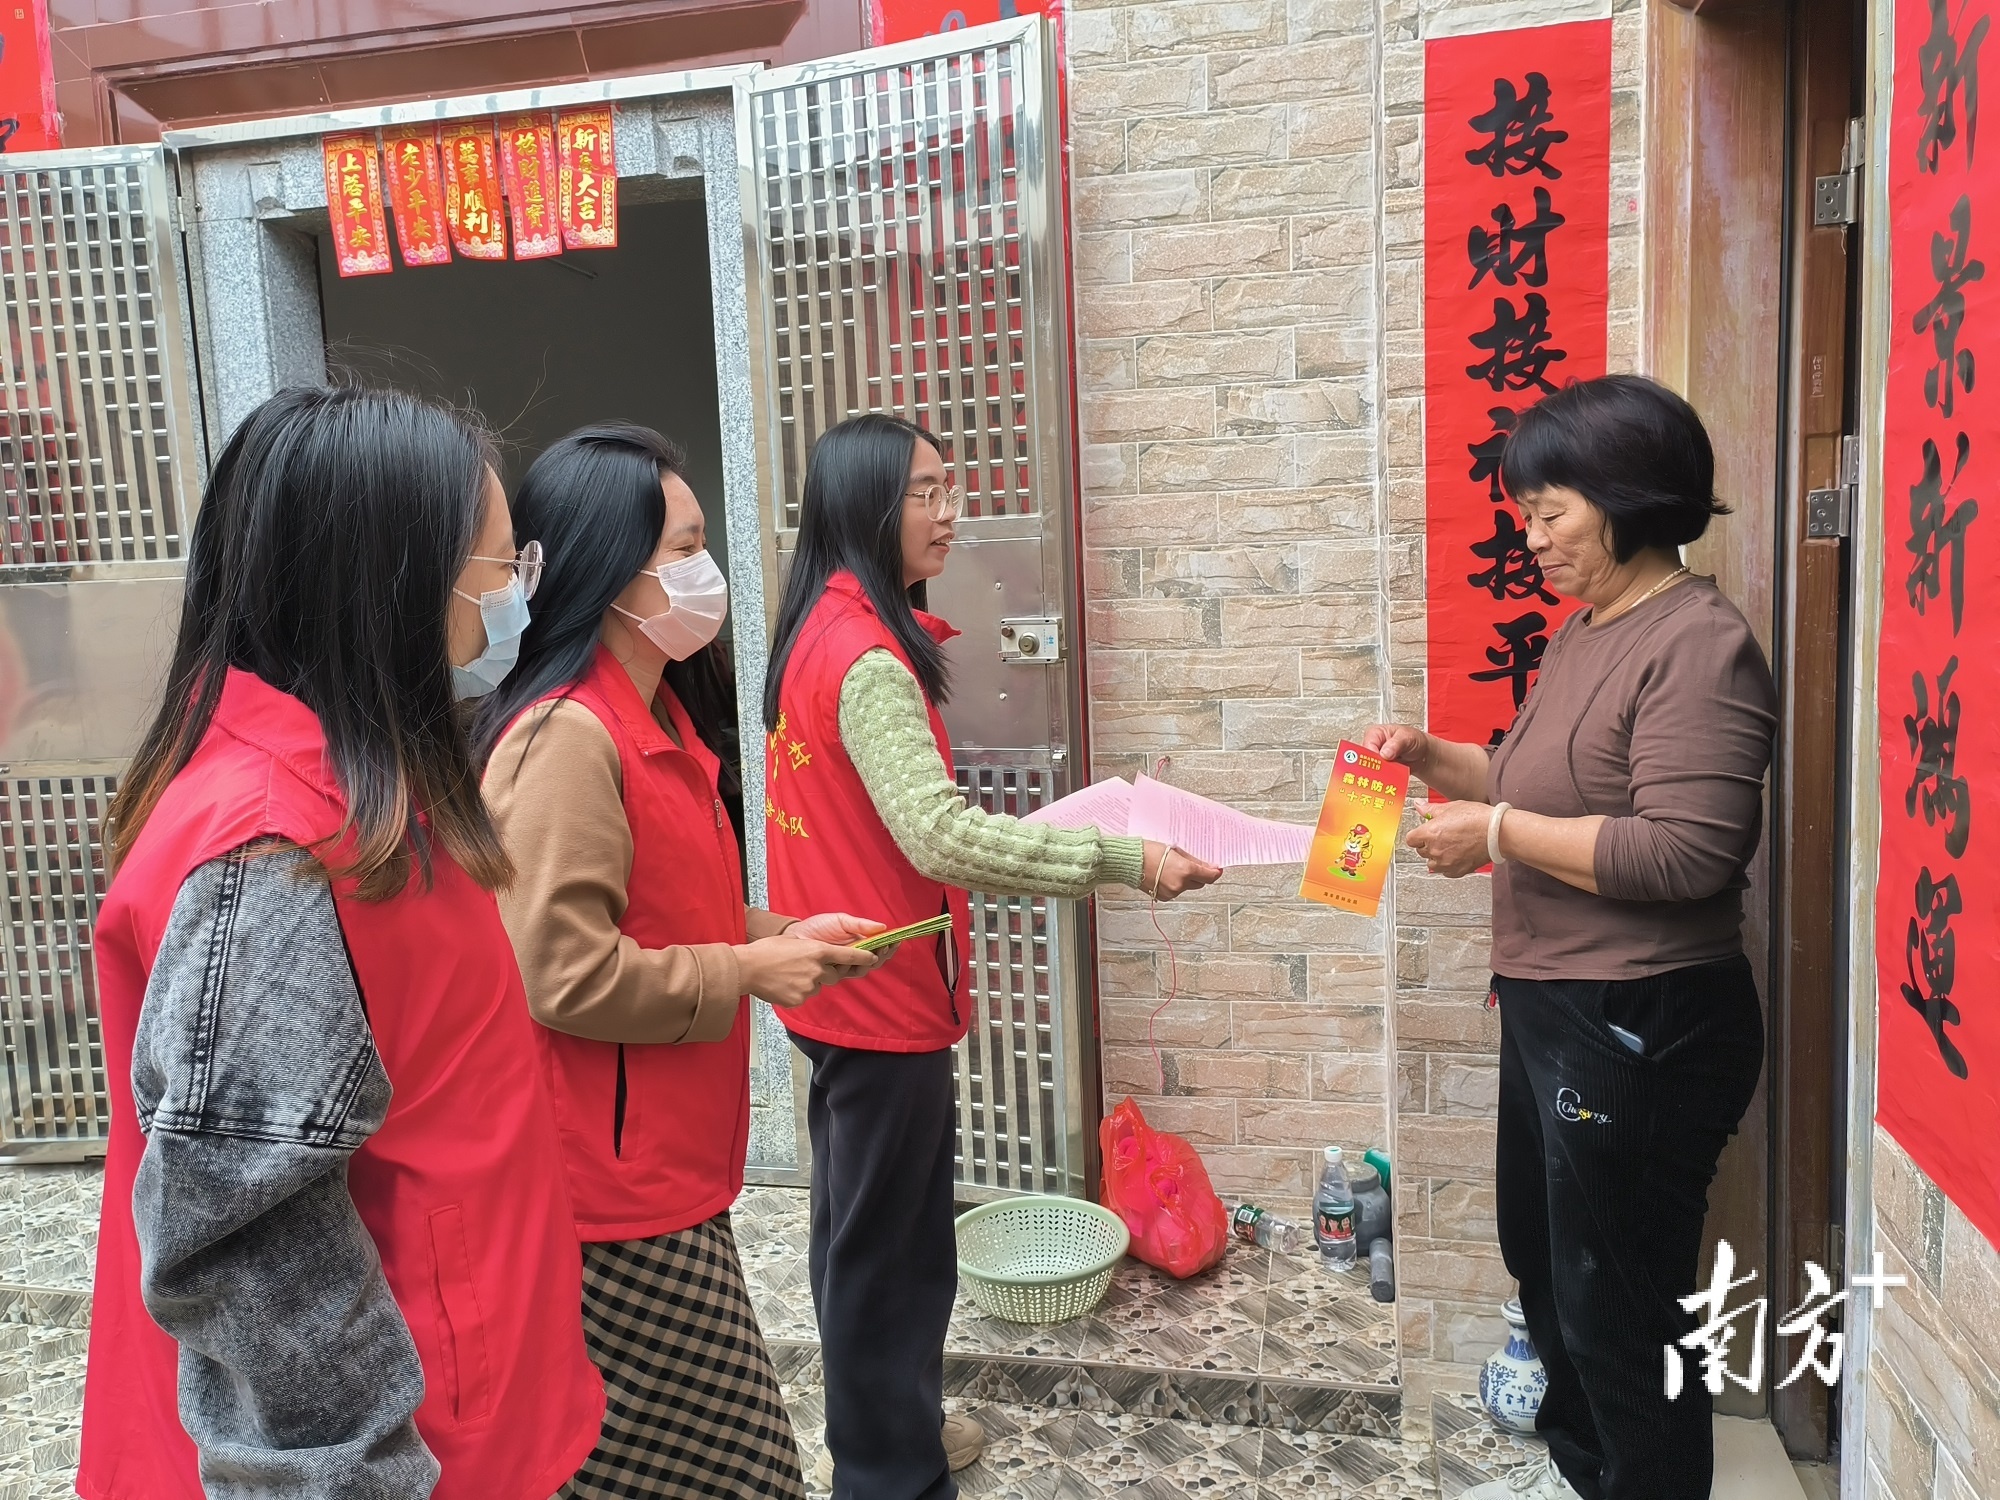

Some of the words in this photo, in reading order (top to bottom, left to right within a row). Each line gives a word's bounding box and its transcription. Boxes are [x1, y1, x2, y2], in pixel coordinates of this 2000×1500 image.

[341, 153, 372, 247] 上落平安
[400, 142, 431, 238] 老少平安
[458, 142, 489, 234] 萬事順利
[515, 133, 544, 229] 招財進寶
[572, 127, 600, 220] 新春大吉
[1465, 72, 1568, 745] 接財接接平
[1342, 772, 1398, 797] 森林防火
